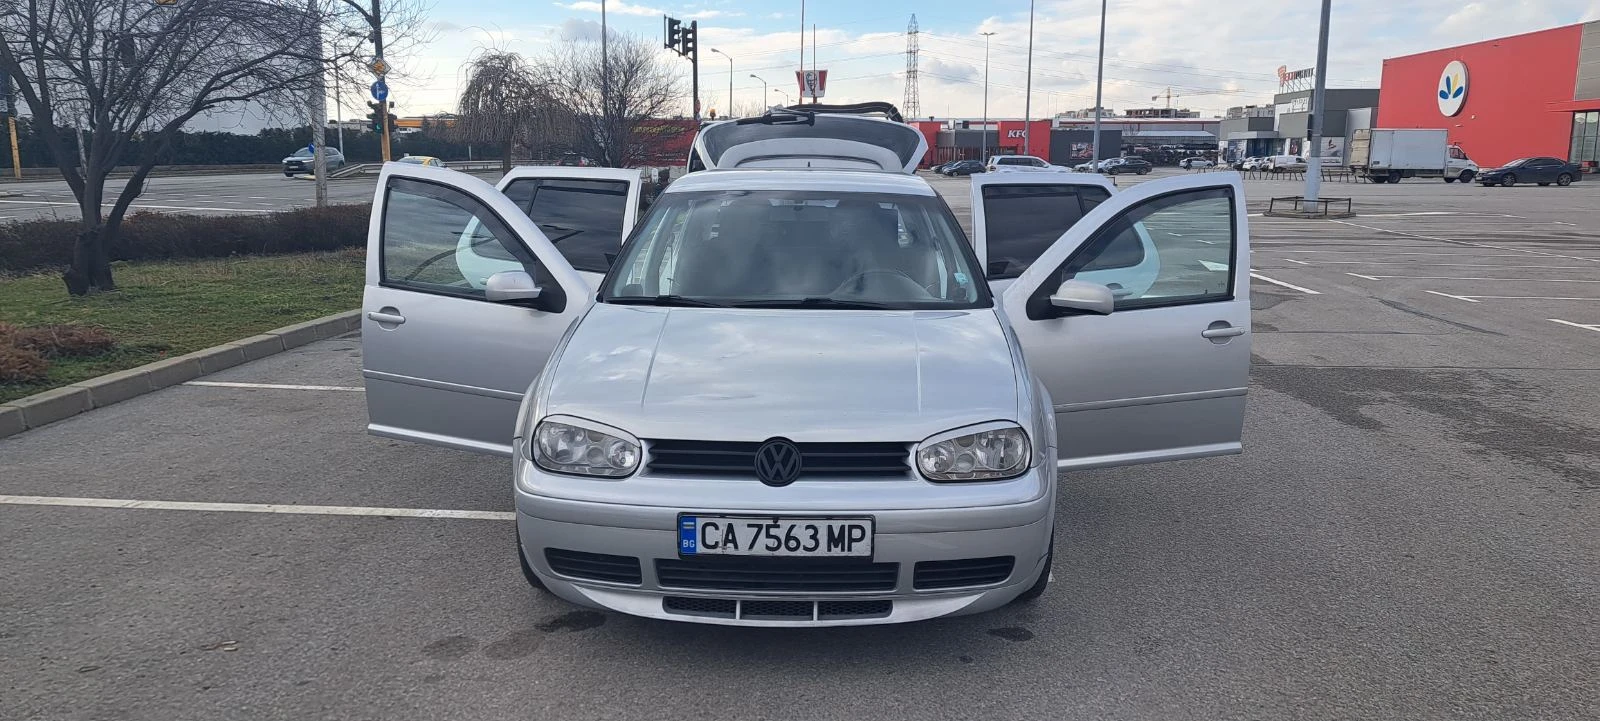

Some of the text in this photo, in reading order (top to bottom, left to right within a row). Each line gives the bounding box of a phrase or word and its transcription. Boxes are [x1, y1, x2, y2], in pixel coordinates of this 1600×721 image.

[682, 539, 695, 548] BG
[701, 521, 866, 553] CA 7563 MP
